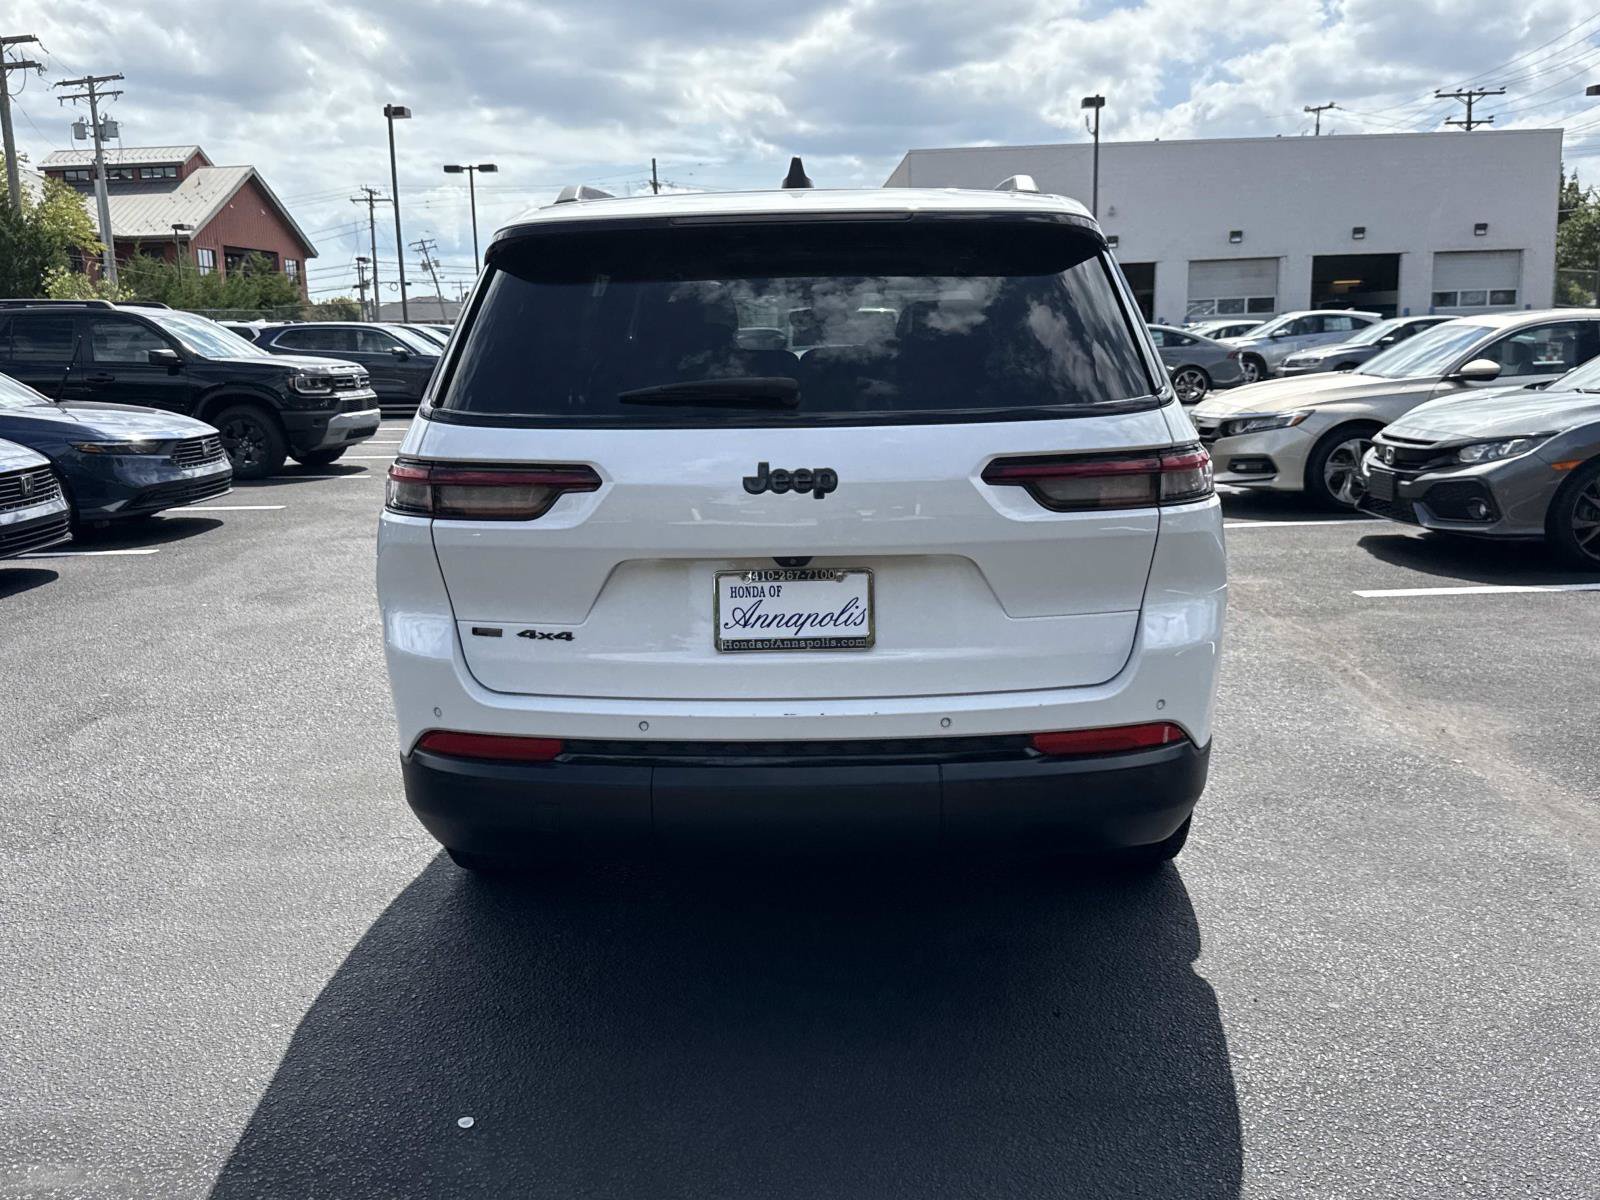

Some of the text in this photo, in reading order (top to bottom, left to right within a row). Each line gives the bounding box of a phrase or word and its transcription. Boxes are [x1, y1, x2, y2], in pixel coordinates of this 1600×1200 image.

[743, 462, 838, 499] Jeep
[751, 569, 835, 581] 410-267-7100
[729, 585, 783, 599] HONDA OF
[723, 597, 867, 636] Annapolis
[516, 629, 575, 641] 4x4
[723, 637, 866, 650] HondaofAnnapolis.com
